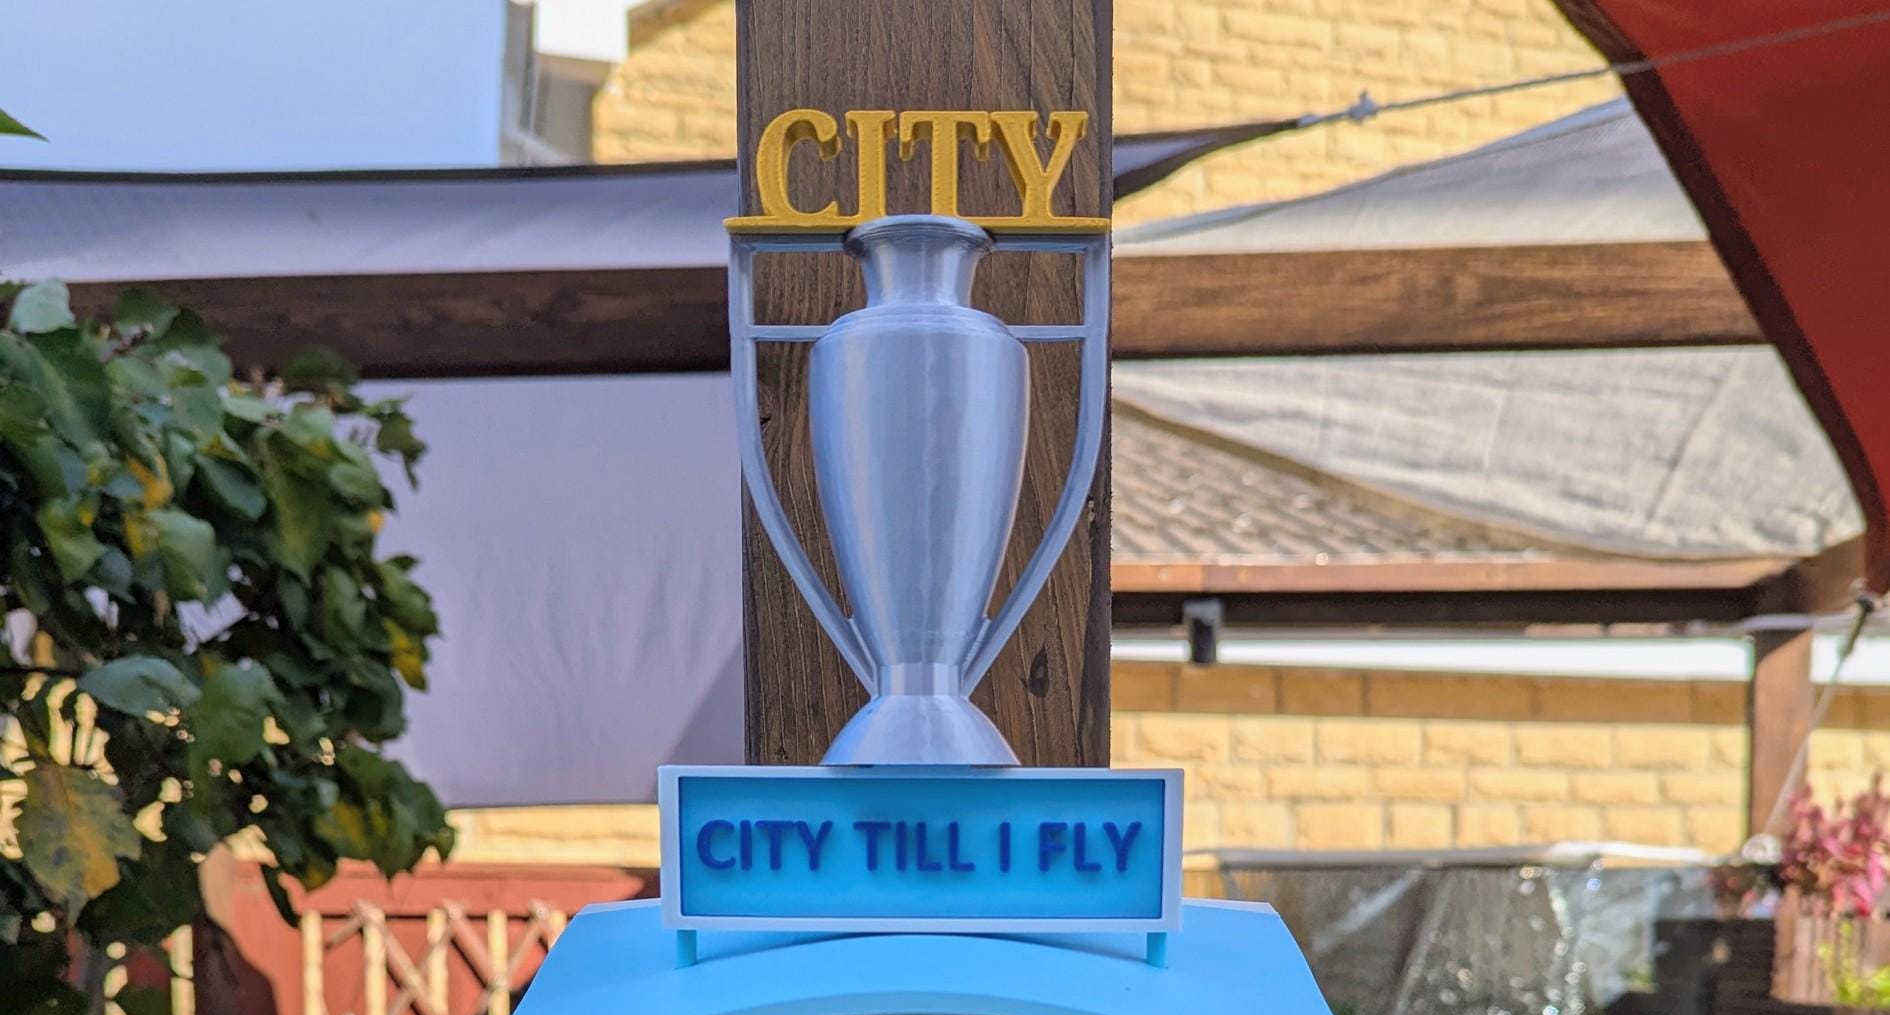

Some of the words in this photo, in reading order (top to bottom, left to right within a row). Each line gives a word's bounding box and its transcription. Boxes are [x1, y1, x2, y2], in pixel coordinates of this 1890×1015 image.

[756, 108, 1089, 220] CITY
[696, 820, 833, 871] CITY
[852, 821, 976, 872] TILL
[998, 821, 1011, 872] I
[1038, 821, 1142, 873] FLY
